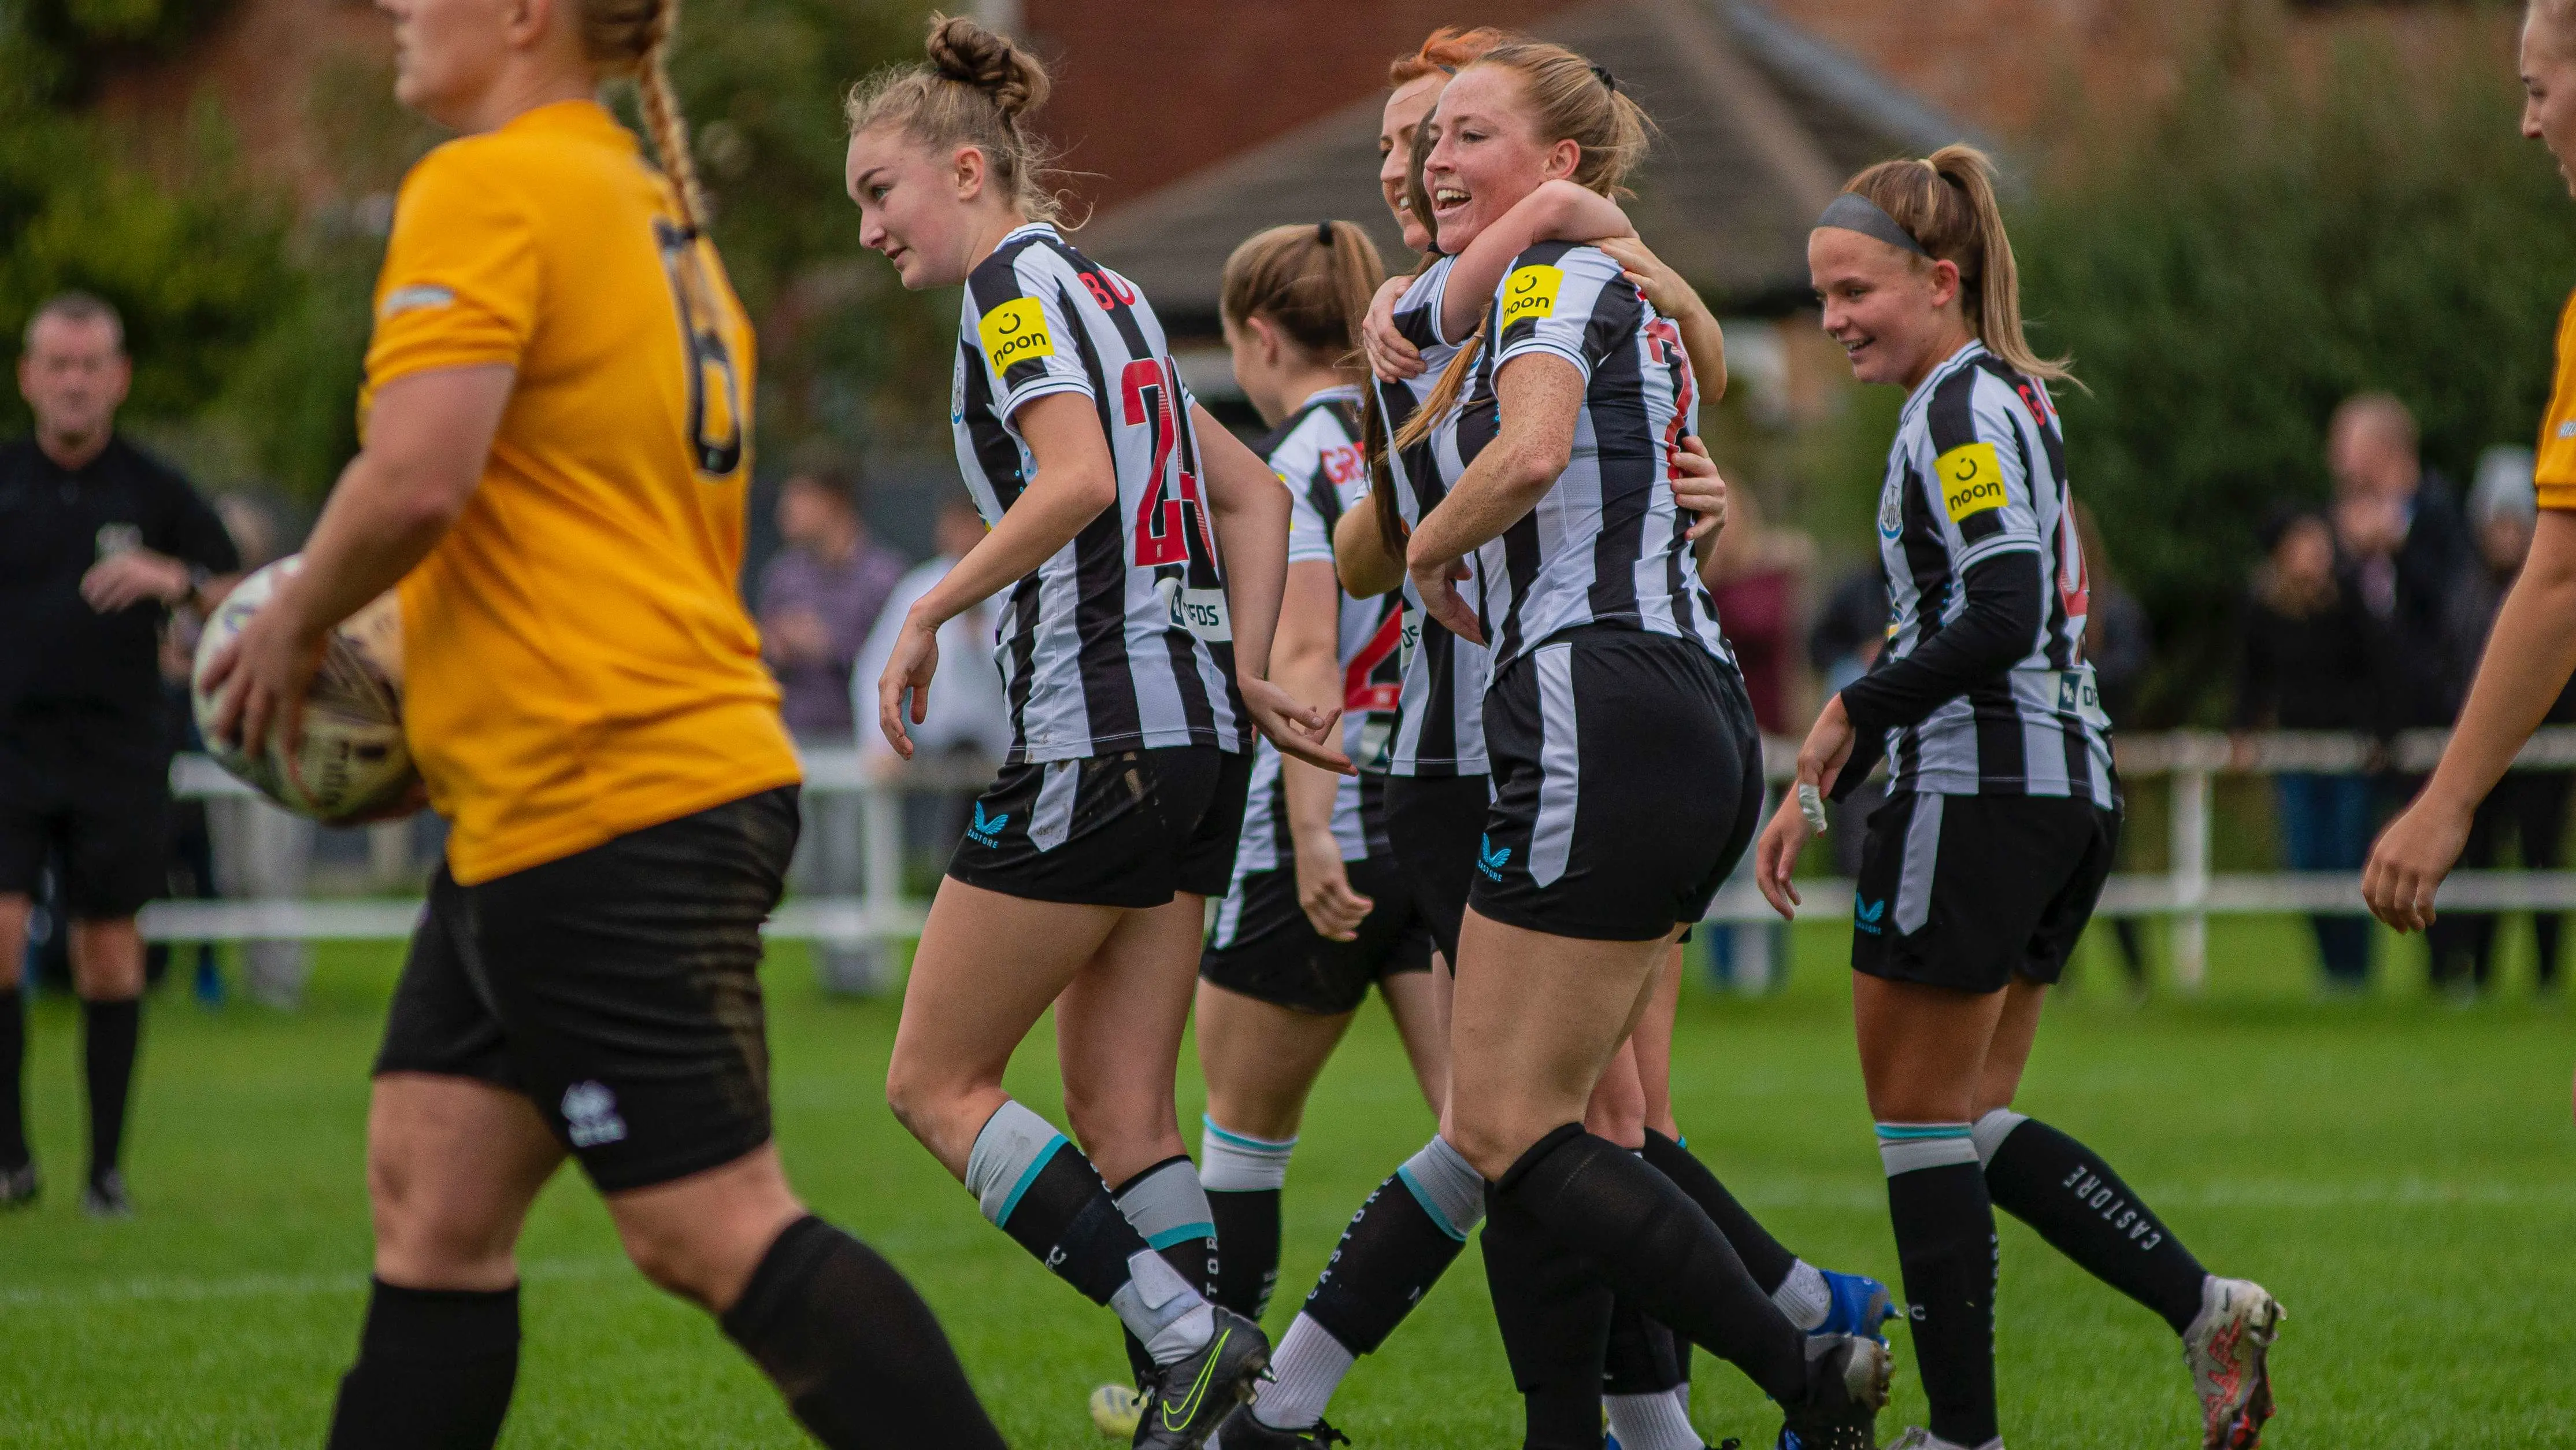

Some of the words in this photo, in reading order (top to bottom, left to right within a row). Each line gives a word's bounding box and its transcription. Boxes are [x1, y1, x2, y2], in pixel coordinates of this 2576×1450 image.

[1077, 269, 1135, 310] BU
[1503, 297, 1550, 324] noon
[993, 332, 1047, 367] noon
[1949, 482, 2001, 511] noon
[968, 828, 999, 849] CASTORE
[1478, 859, 1503, 882] CASTORE
[2062, 1163, 2162, 1251] CASTORE
